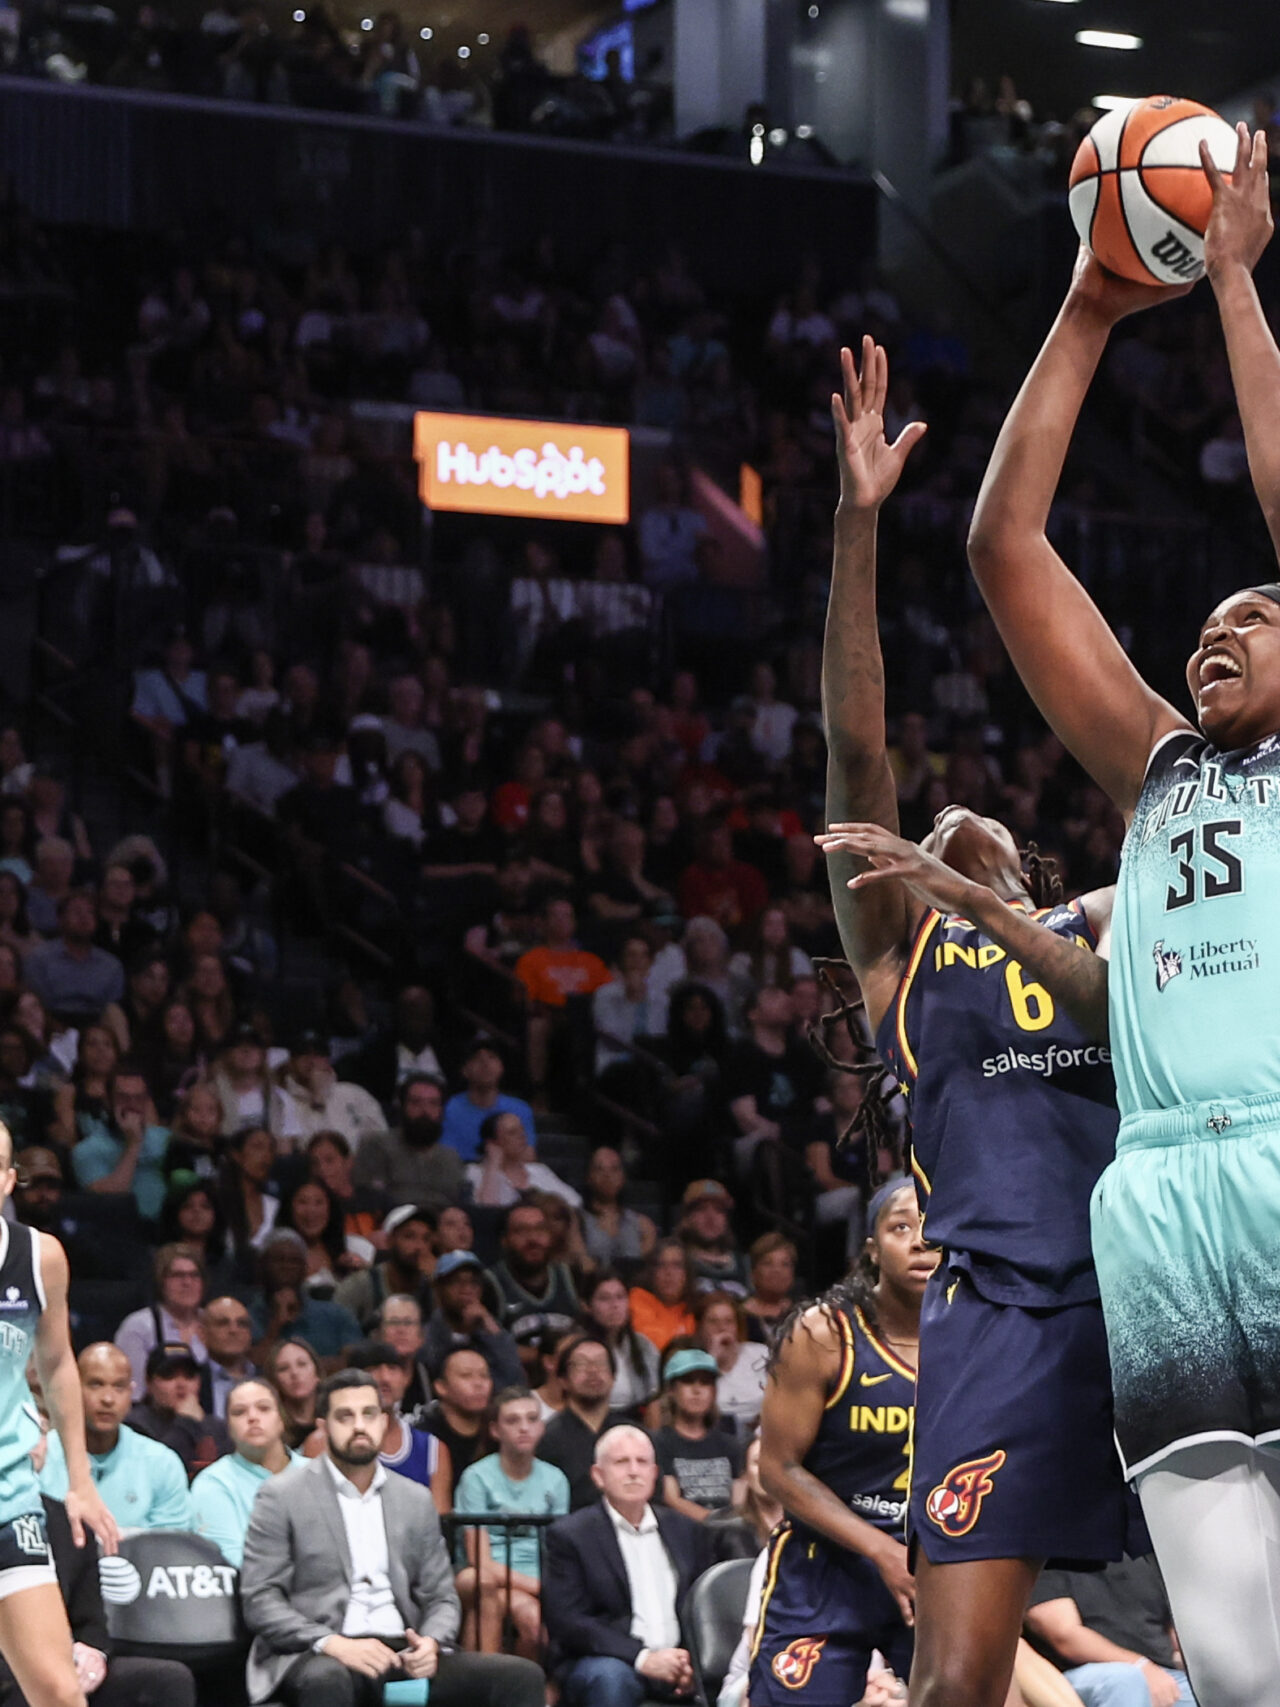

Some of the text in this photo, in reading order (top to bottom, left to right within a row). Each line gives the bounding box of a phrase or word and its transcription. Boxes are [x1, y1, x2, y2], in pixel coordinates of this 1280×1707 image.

[437, 441, 606, 499] HubSpot
[1164, 818, 1246, 914] 35
[1188, 938, 1258, 961] Liberty
[1189, 952, 1260, 980] Mutual
[1004, 959, 1055, 1032] 6
[982, 1044, 1113, 1078] salesforce
[146, 1565, 238, 1599] AT&T
